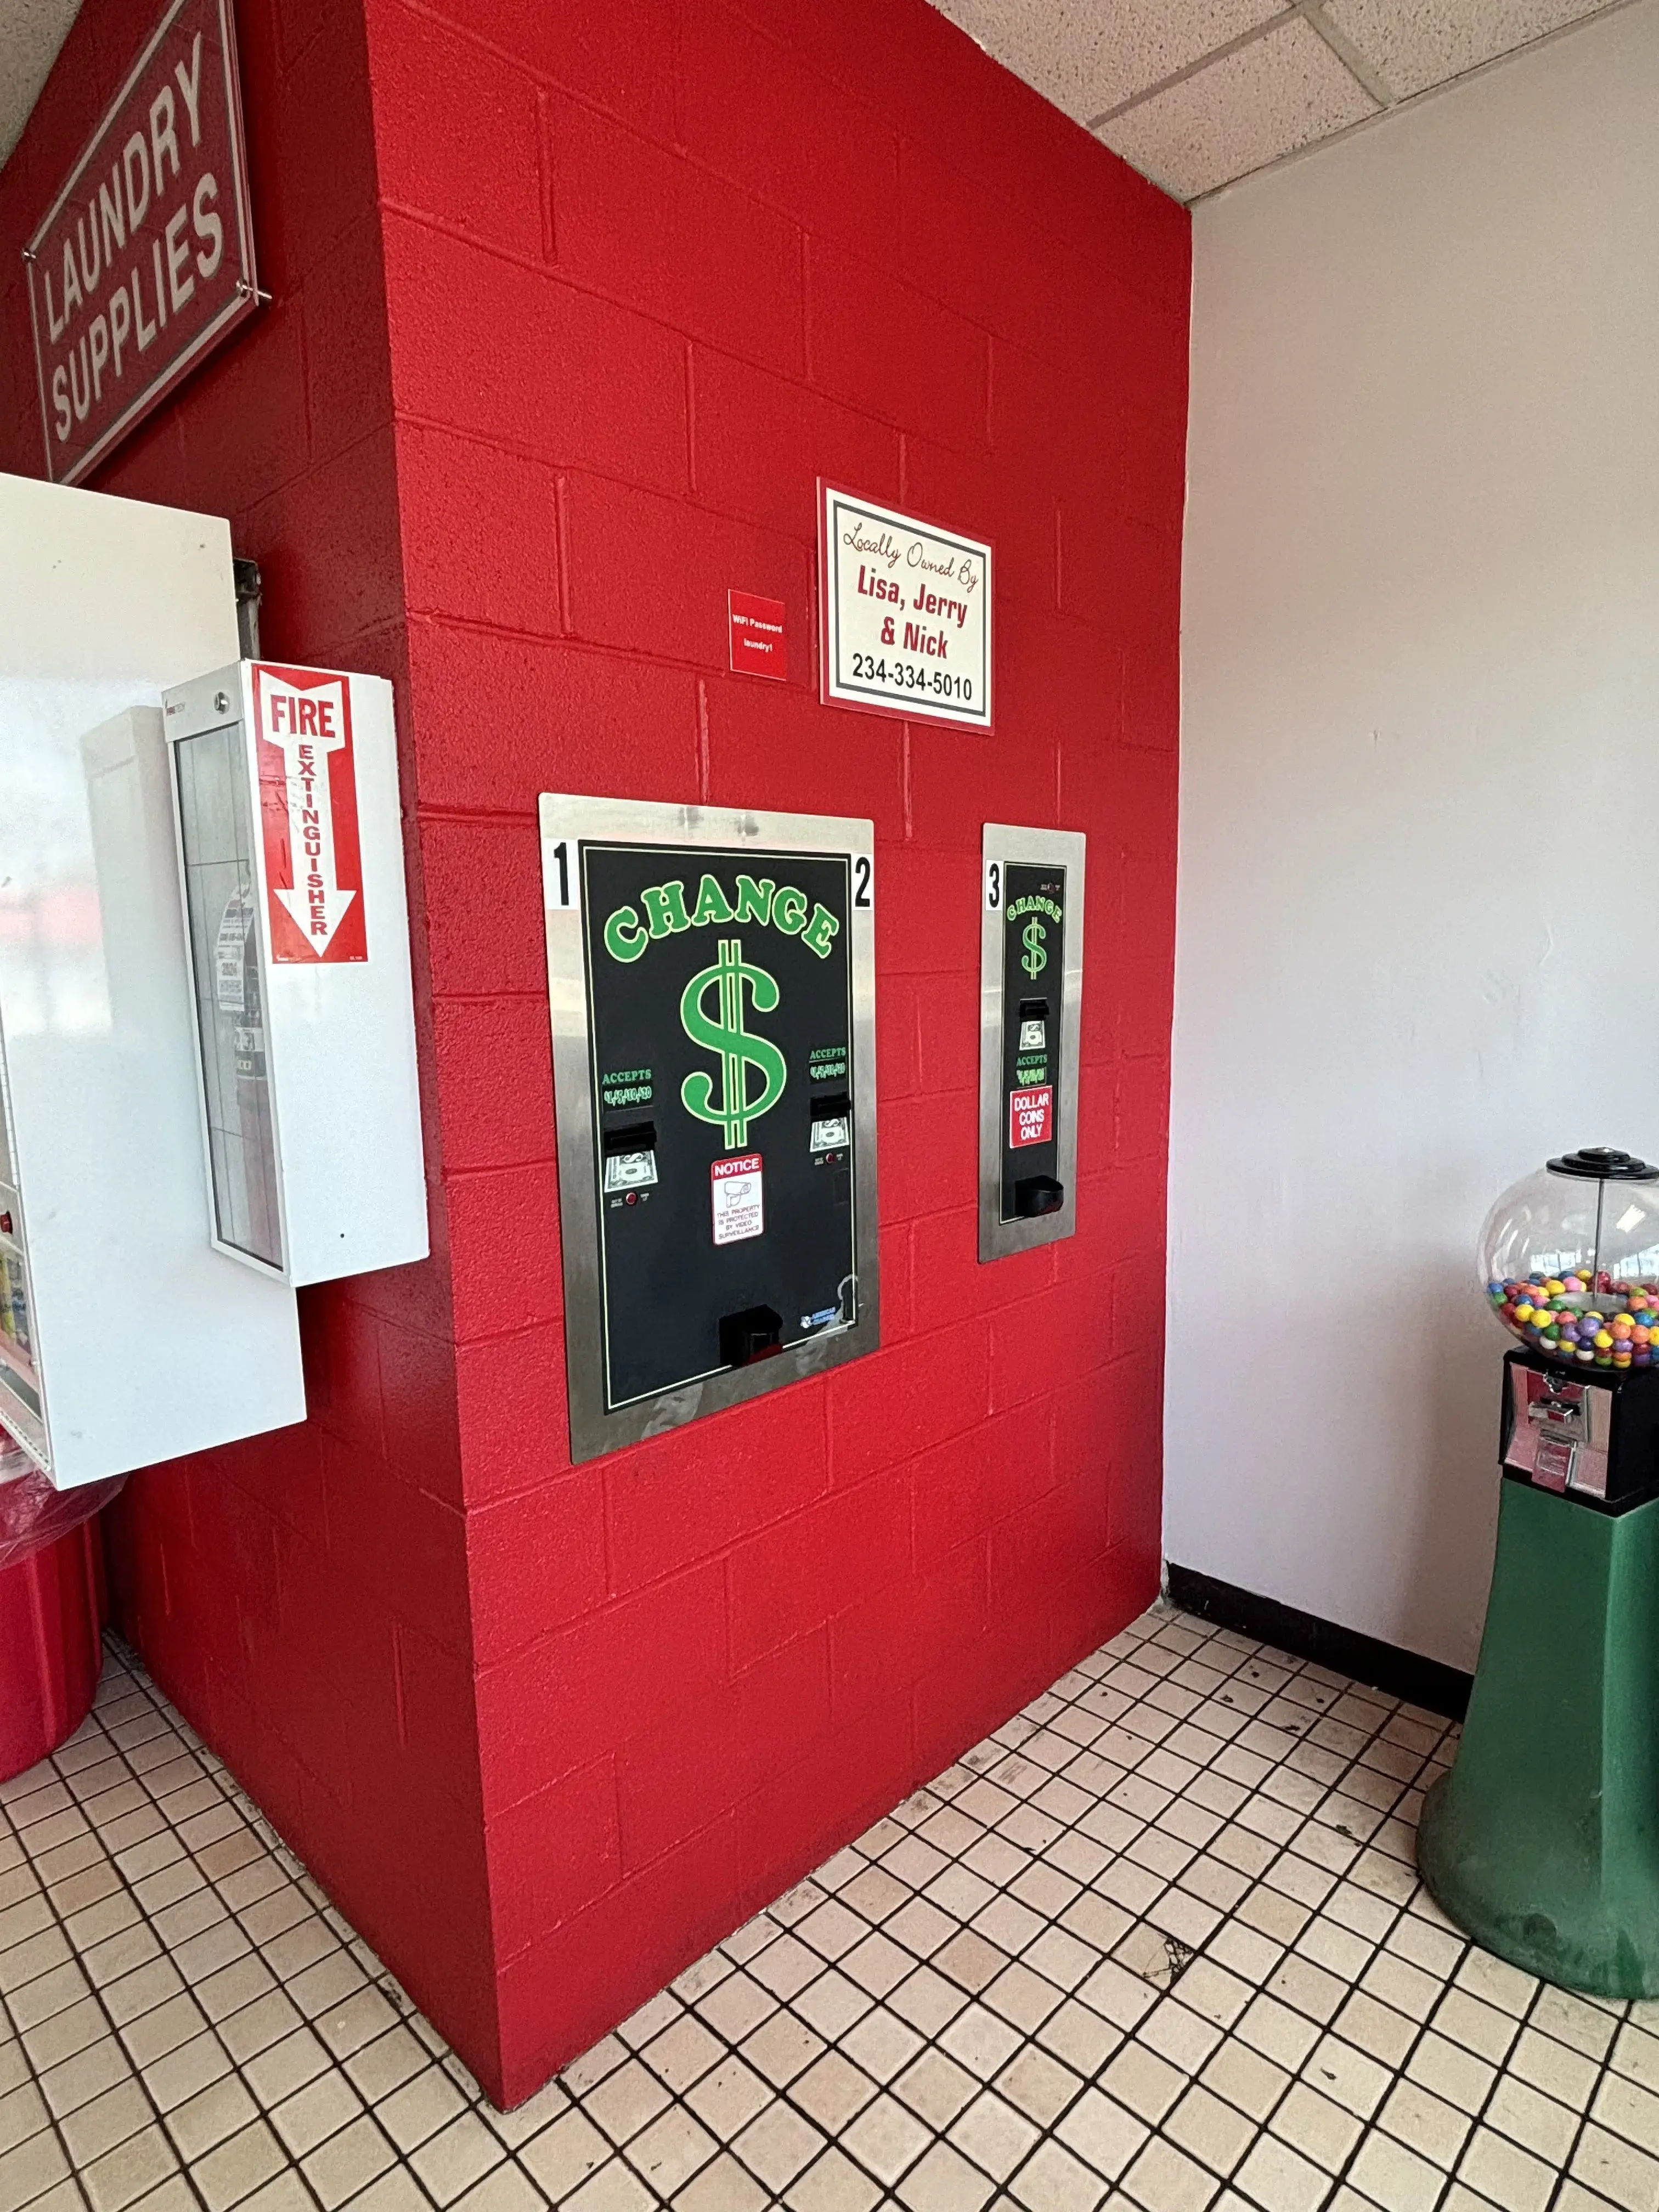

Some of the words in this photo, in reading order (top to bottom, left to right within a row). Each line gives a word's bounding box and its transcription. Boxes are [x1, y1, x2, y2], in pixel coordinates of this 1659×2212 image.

[44, 31, 202, 344] LAUNDRY
[52, 173, 223, 441] SUPPLIES
[843, 522, 901, 568] Locally
[907, 542, 955, 577] Owned
[957, 558, 979, 593] By
[857, 565, 905, 611] Lisa,
[913, 583, 968, 629] Jerry
[749, 618, 782, 633] Password
[881, 616, 895, 646] &
[903, 621, 948, 659] Nick
[853, 653, 972, 701] 234-334-5010
[270, 695, 336, 738] FIRE
[298, 744, 328, 936] EXTINGUISHER
[554, 842, 569, 906] 1
[855, 857, 871, 907] 2
[989, 863, 1000, 908] 3
[604, 874, 839, 963] CHANGE
[1007, 895, 1062, 924] CHANGE
[810, 1047, 846, 1060] ACCEPTS
[602, 1069, 652, 1085] ACCEPTS
[1014, 1093, 1049, 1111] DOLLAR
[1021, 1124, 1042, 1140] ONLY
[715, 1158, 759, 1176] NOTICE
